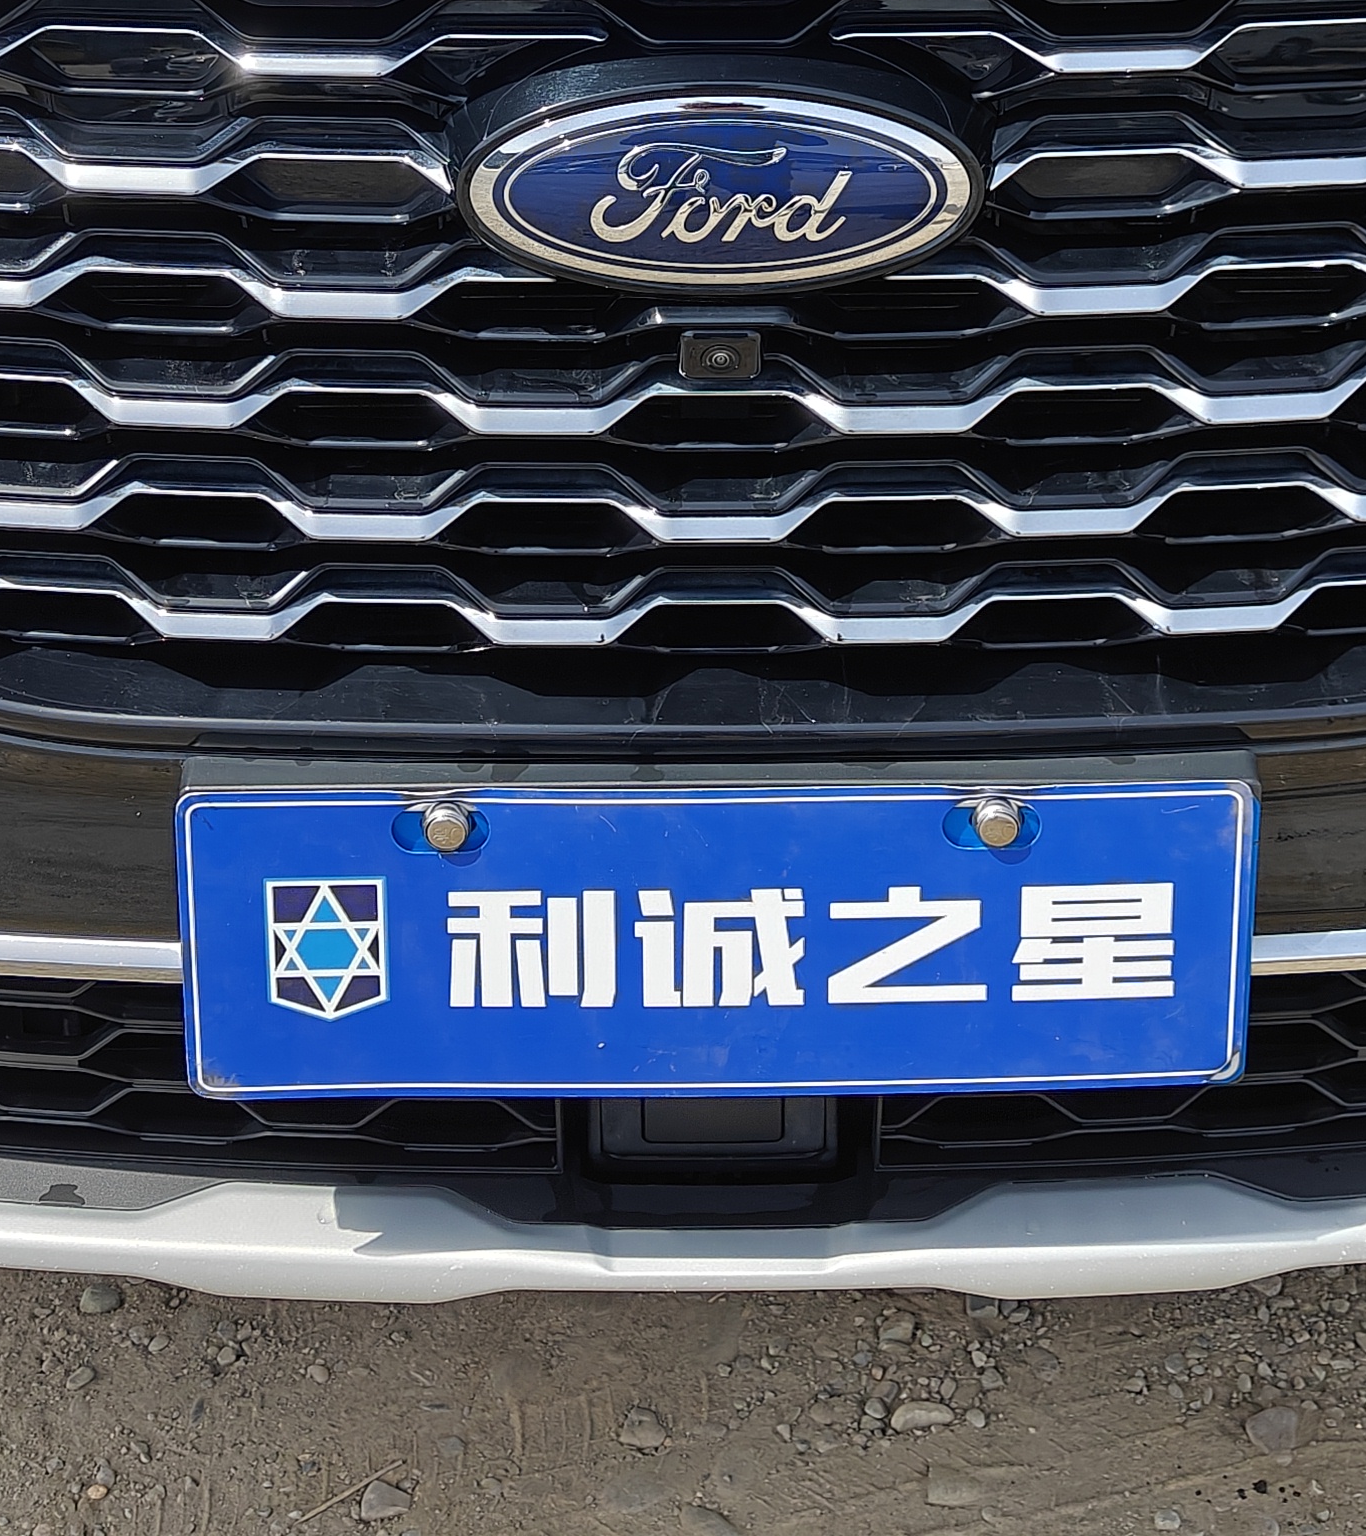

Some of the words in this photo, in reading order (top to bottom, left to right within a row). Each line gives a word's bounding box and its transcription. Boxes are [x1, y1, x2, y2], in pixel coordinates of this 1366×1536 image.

[589, 140, 853, 243] Ford
[445, 882, 1176, 1009] 利诚之星
